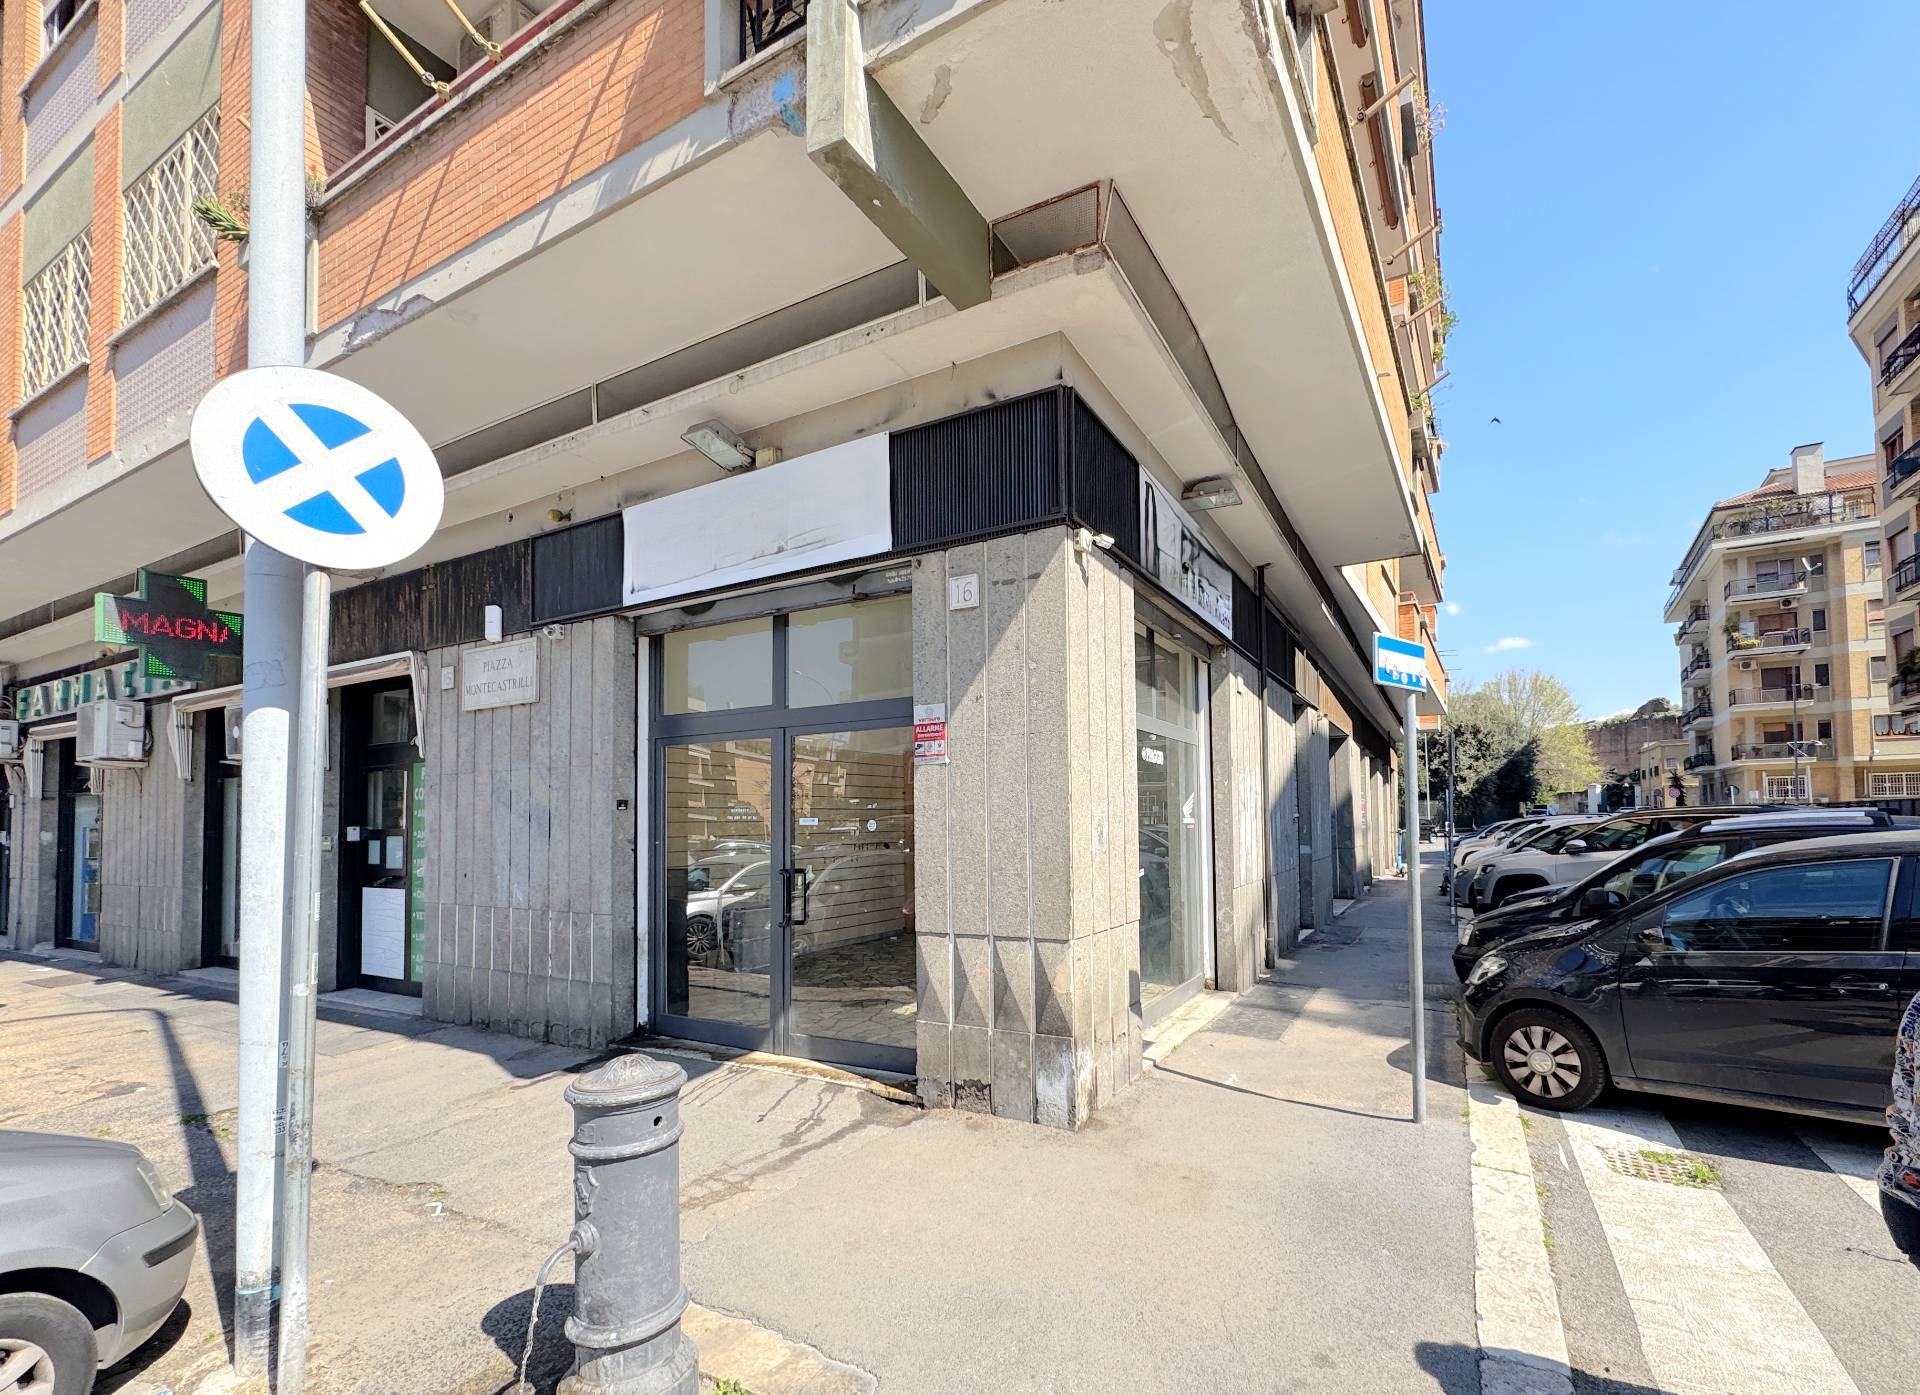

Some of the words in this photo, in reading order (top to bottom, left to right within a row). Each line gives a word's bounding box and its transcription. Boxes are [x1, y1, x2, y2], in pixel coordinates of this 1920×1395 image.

[956, 580, 974, 604] 16
[483, 657, 513, 673] PIAZZA
[465, 674, 533, 698] MONTECASTRILLI
[915, 722, 945, 734] ALLARME
